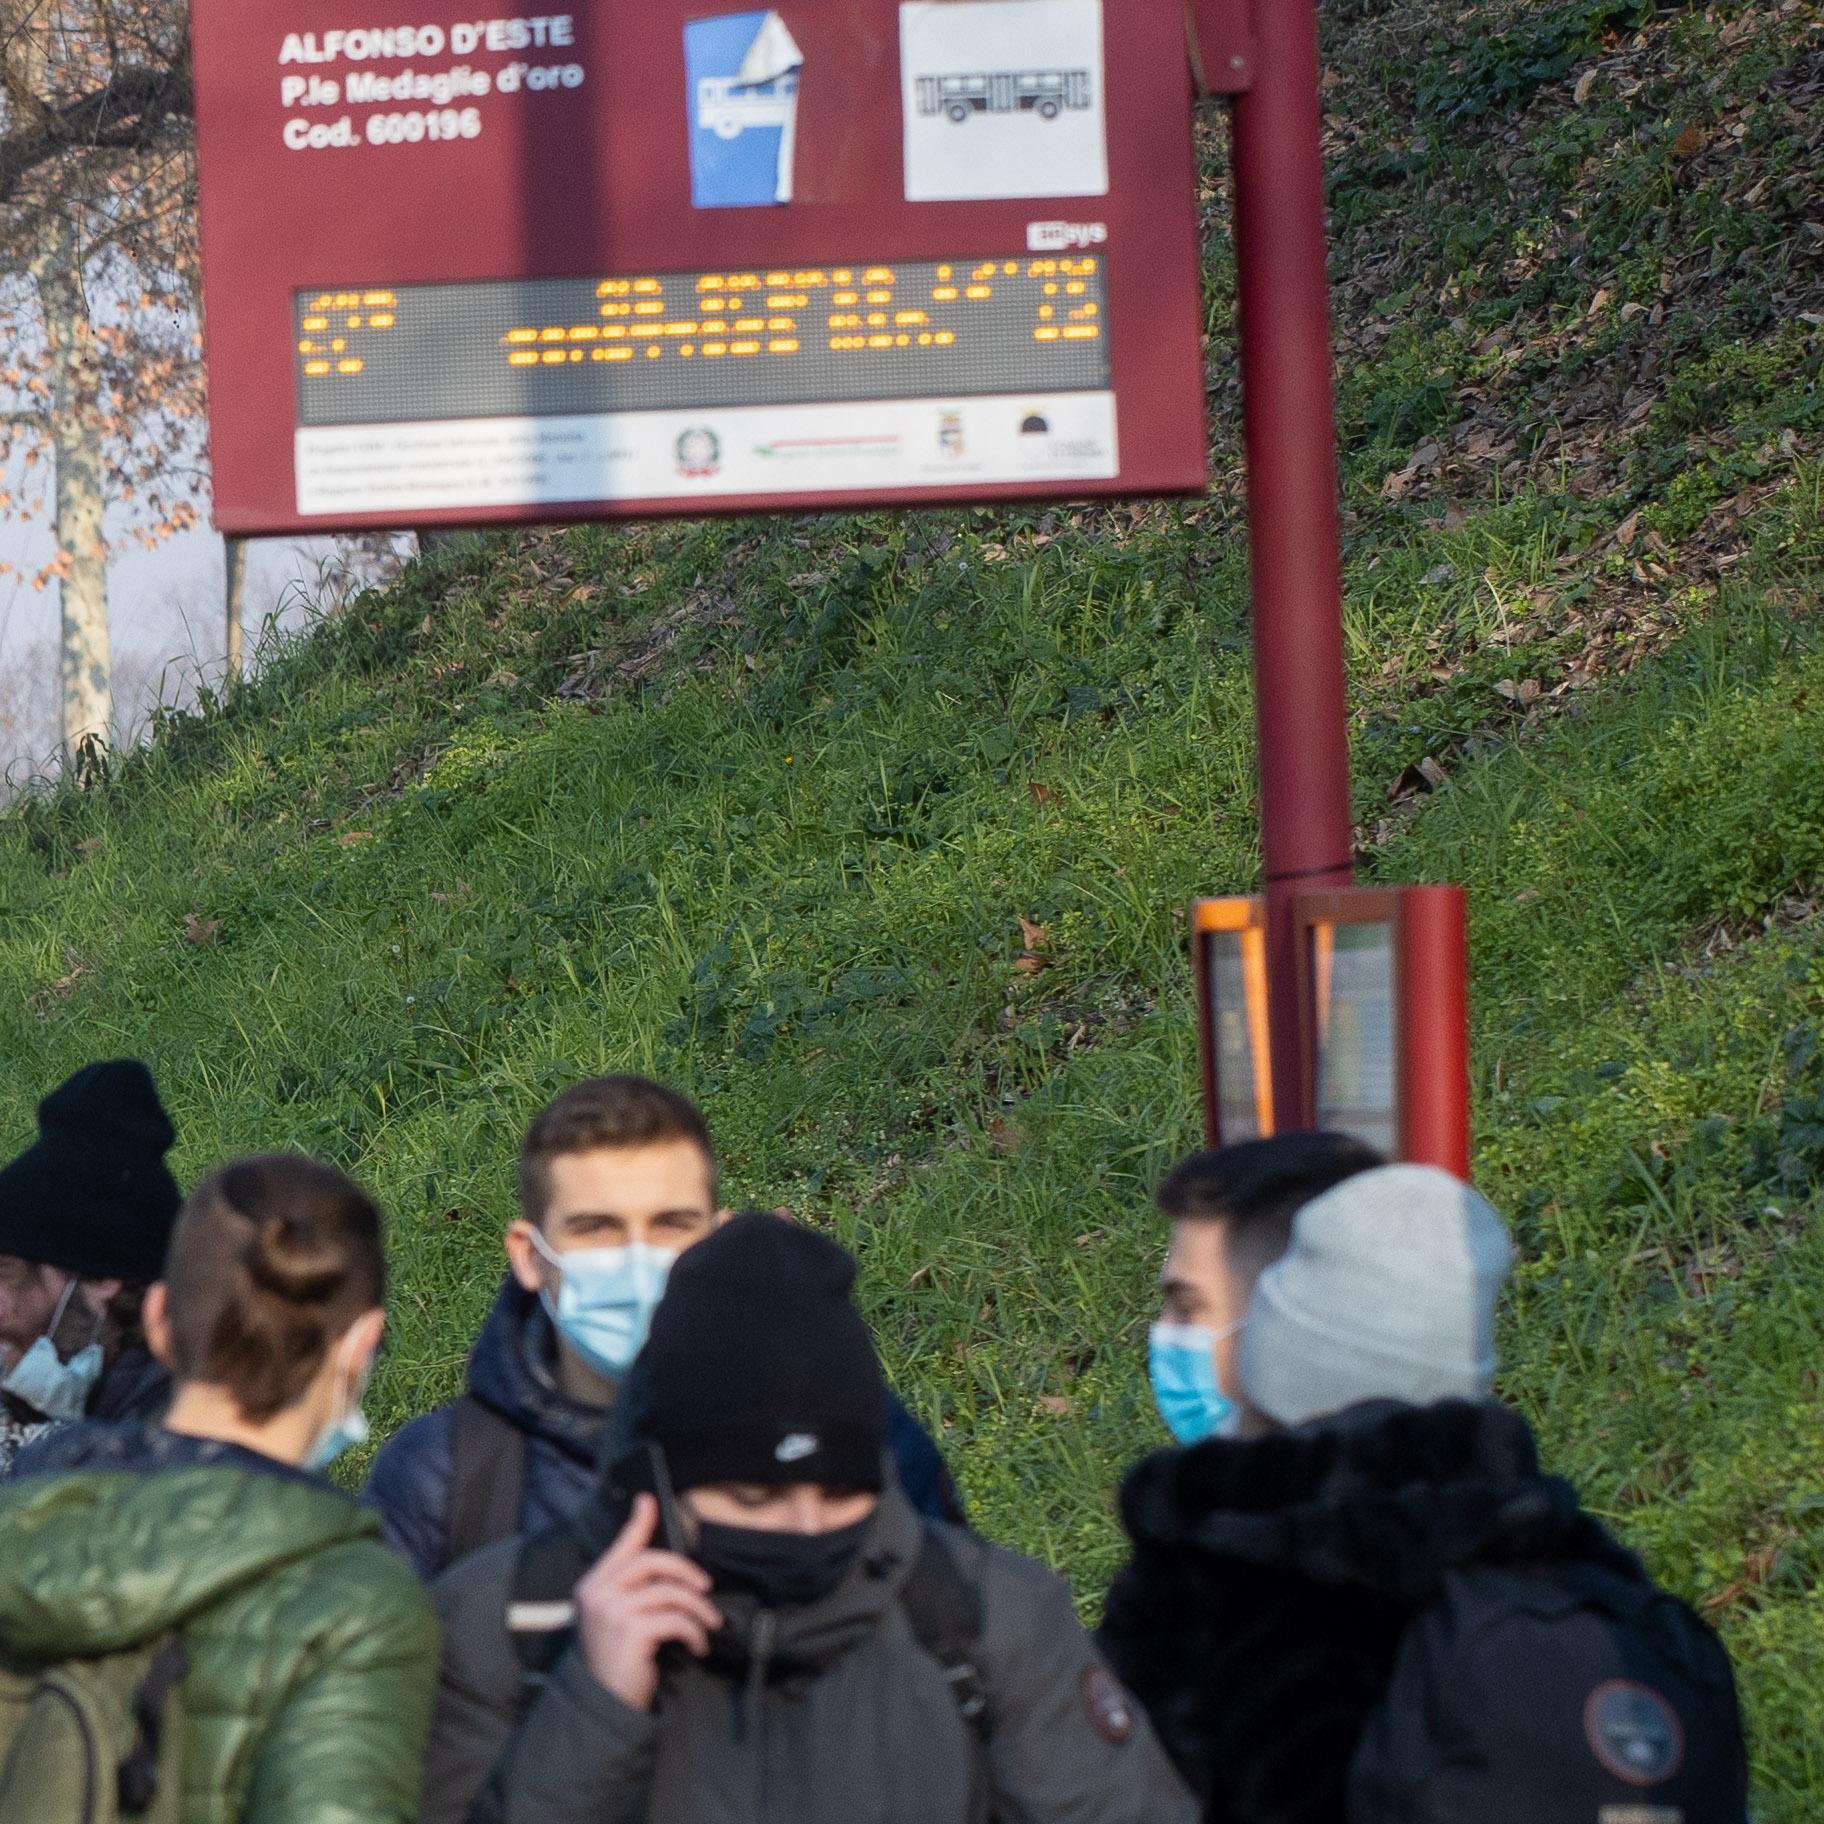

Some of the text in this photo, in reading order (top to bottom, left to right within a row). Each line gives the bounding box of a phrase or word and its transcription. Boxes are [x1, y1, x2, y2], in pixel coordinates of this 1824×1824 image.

[278, 15, 574, 64] ALFONSO D'ESTE
[281, 61, 584, 107] P.le Medaglie d'oro
[283, 106, 482, 150] Cod. 600196
